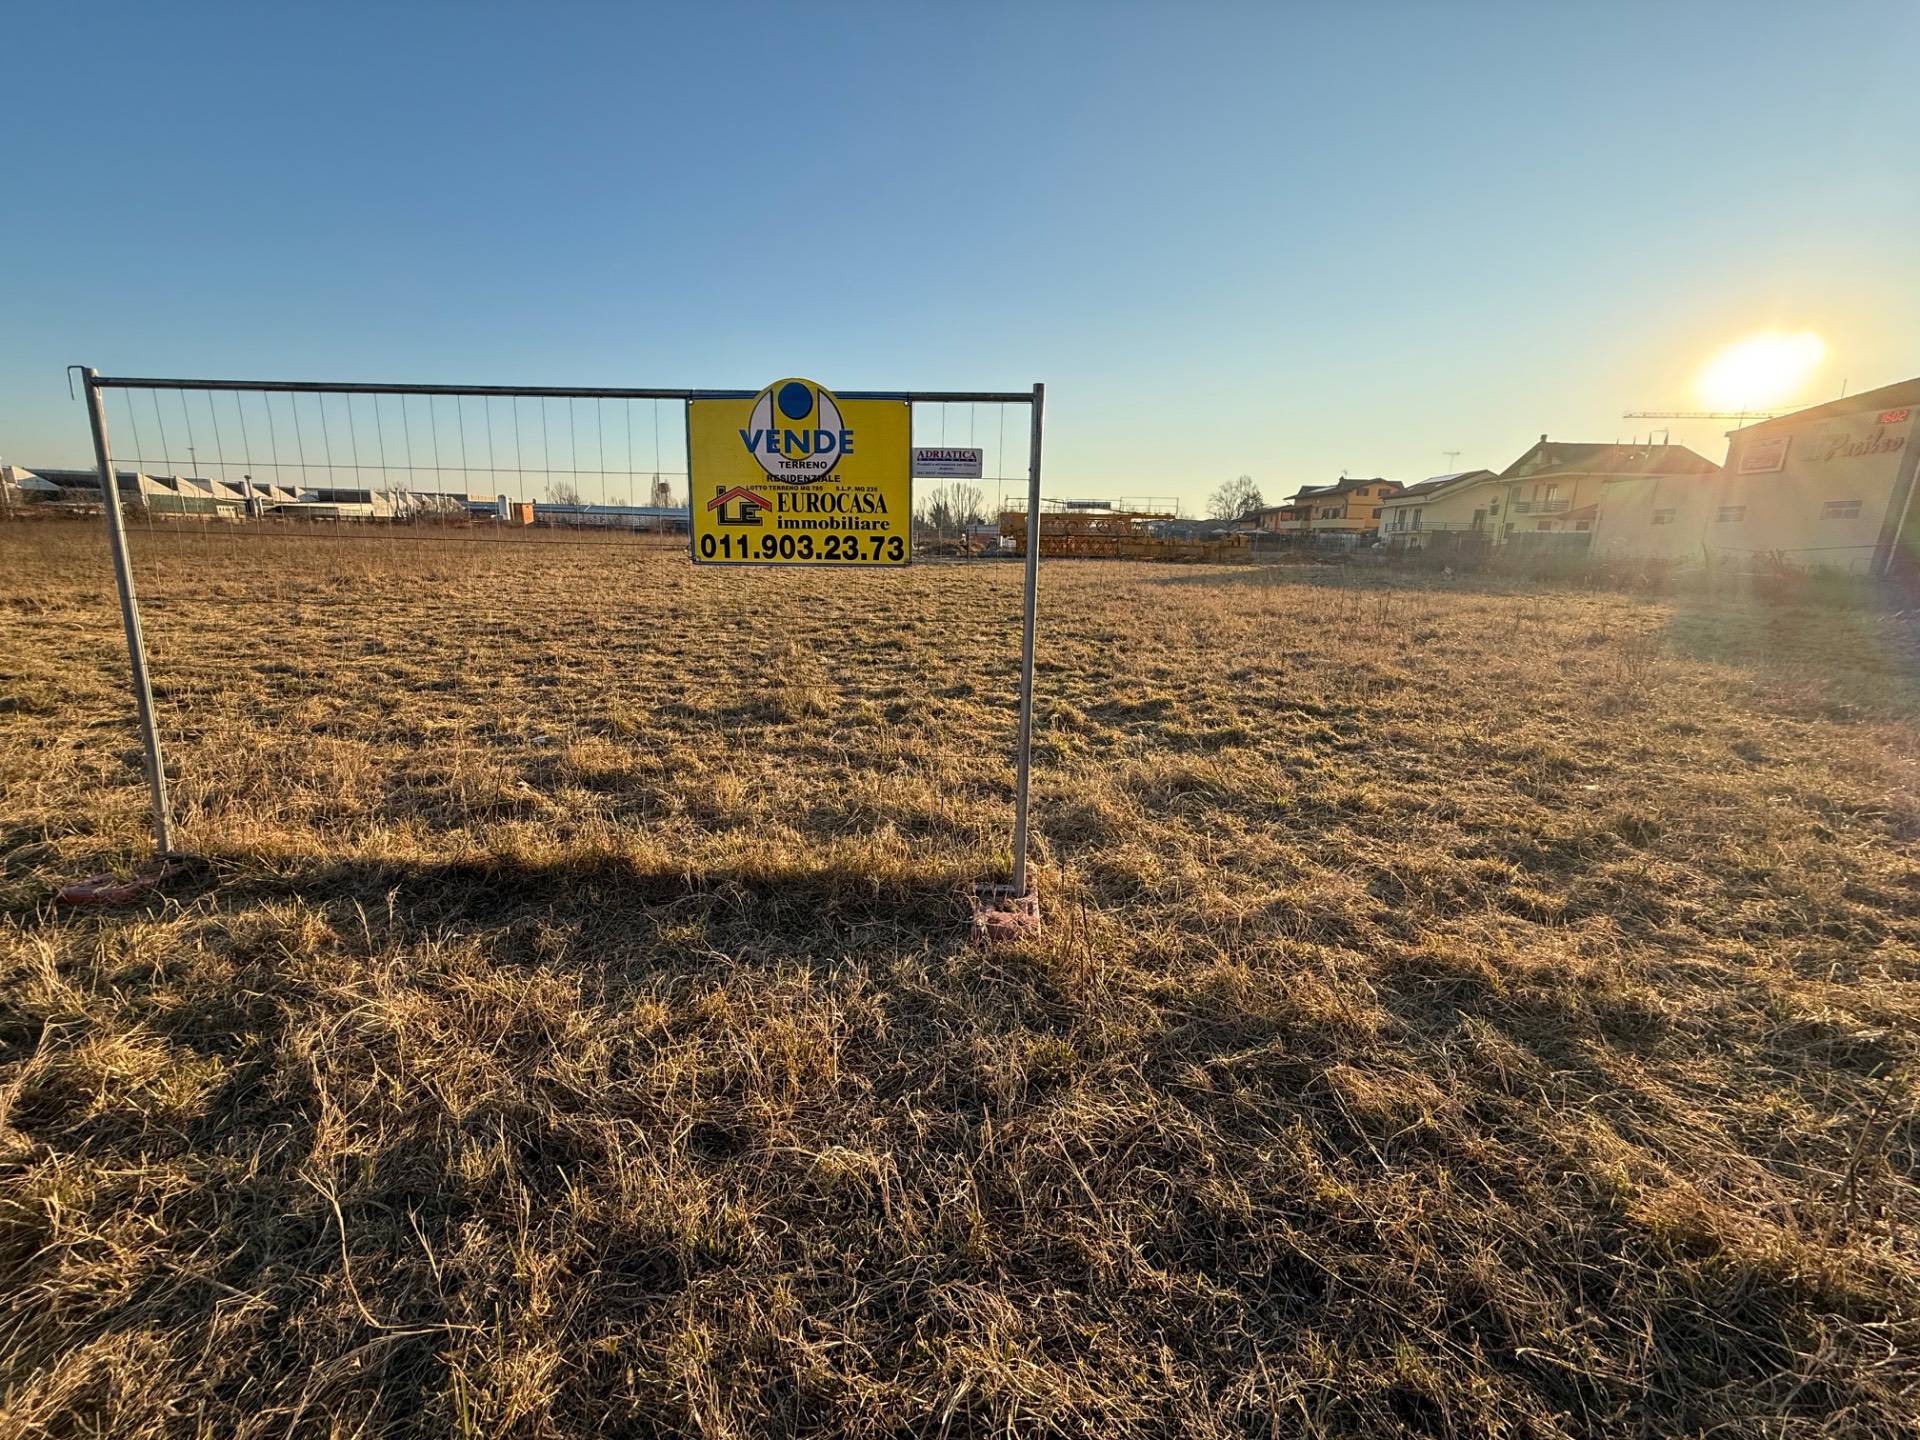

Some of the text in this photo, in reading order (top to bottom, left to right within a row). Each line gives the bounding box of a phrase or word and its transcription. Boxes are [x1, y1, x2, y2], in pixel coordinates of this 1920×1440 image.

[739, 429, 854, 454] VENDE
[917, 450, 976, 459] ADRIATICA
[779, 461, 827, 469] TERRENO
[766, 474, 841, 483] RESIDENZIALE
[777, 492, 888, 514] EUROCASA
[777, 516, 890, 530] immobiliare
[700, 533, 905, 561] 011.903.23.73
